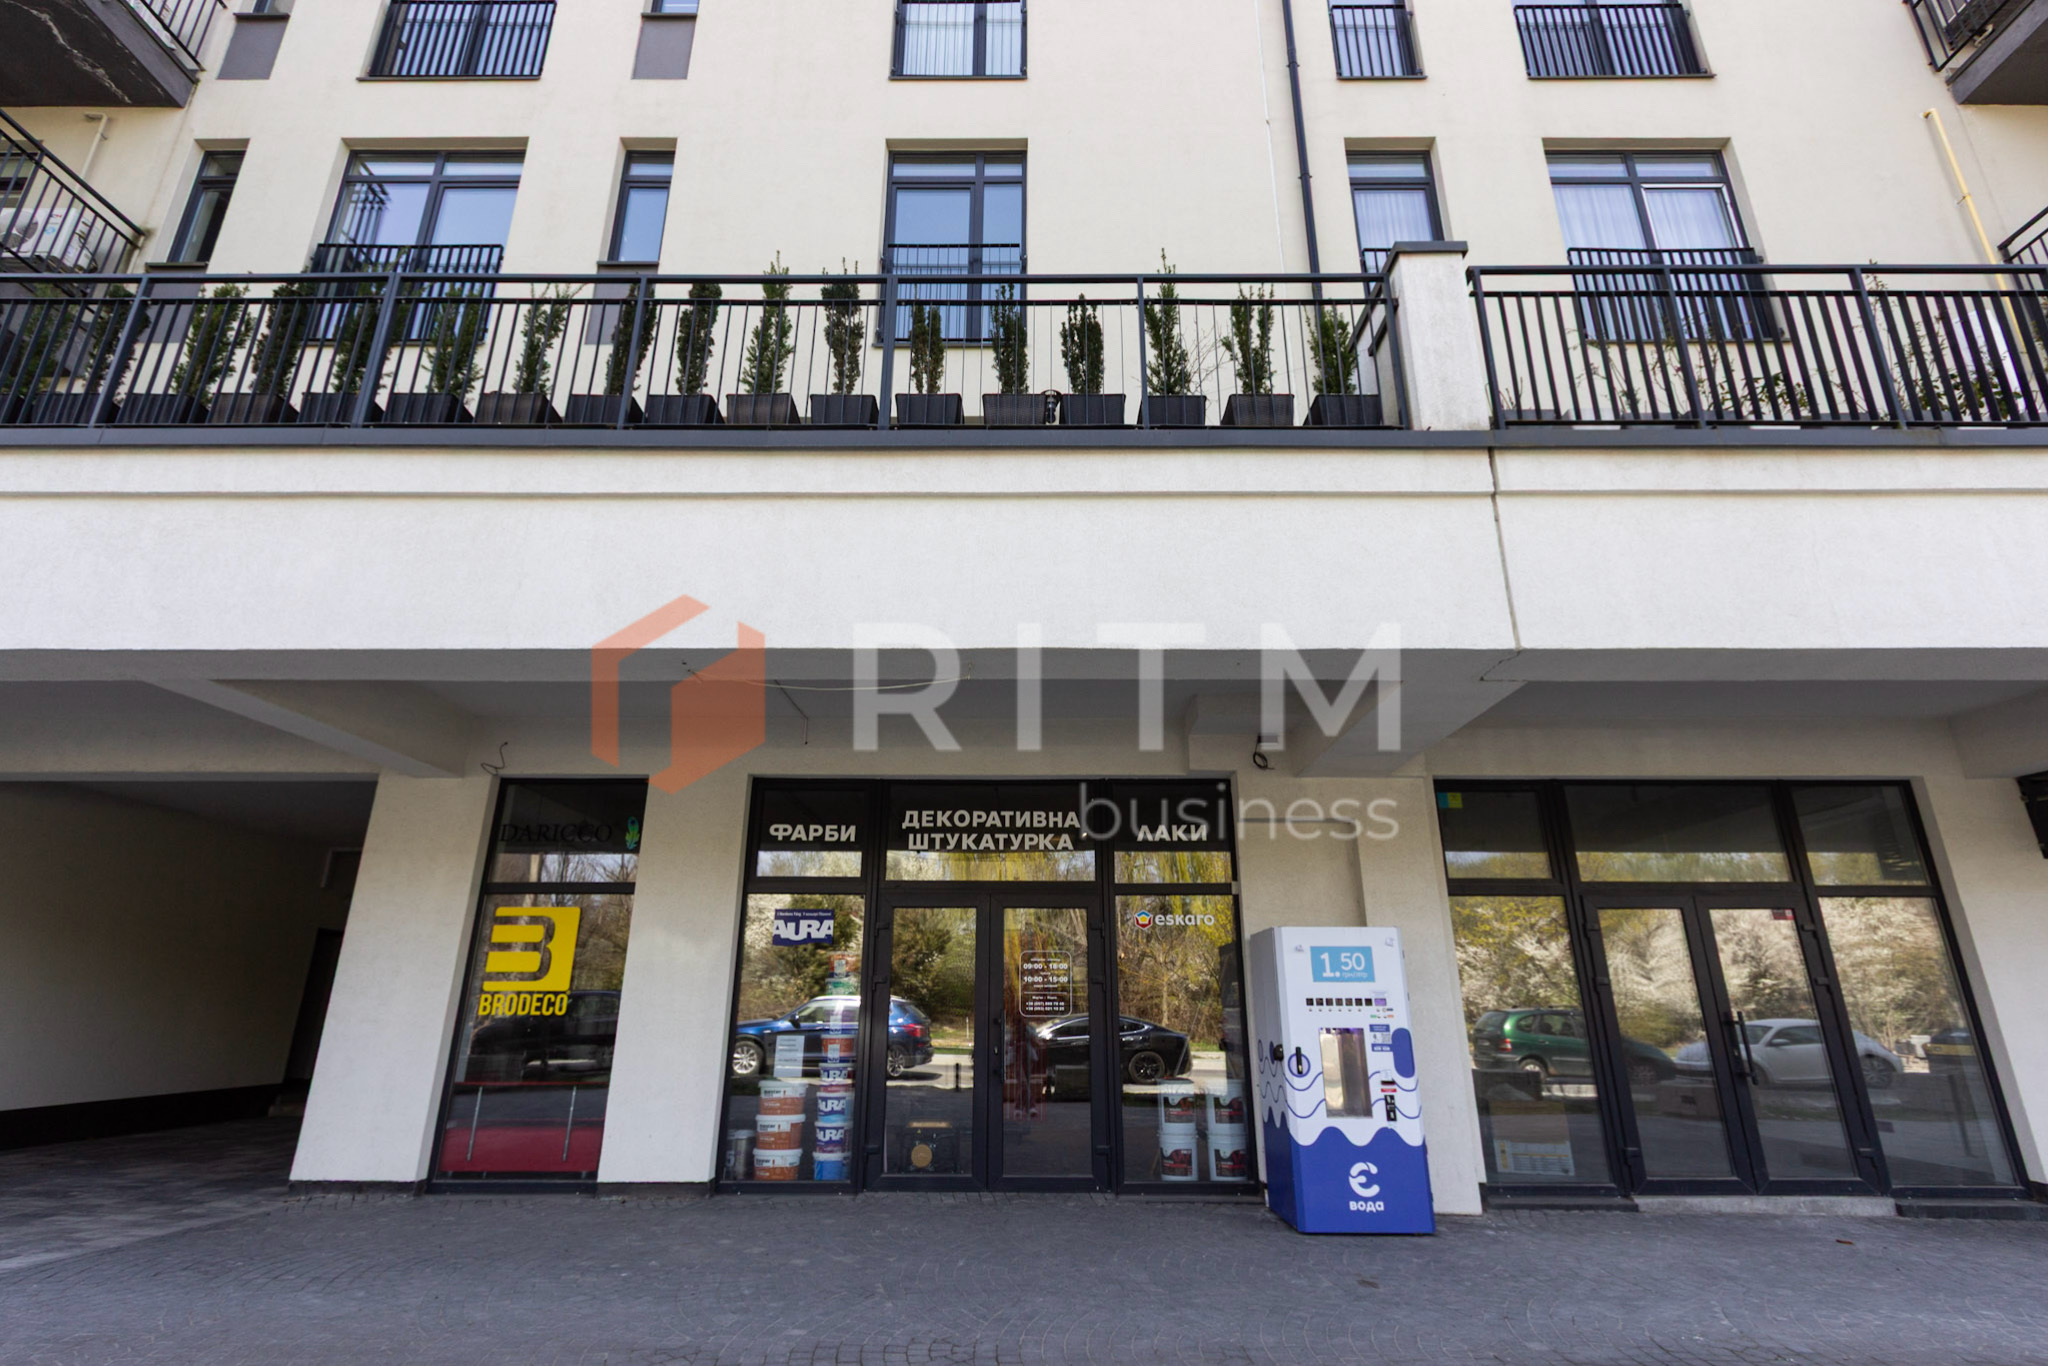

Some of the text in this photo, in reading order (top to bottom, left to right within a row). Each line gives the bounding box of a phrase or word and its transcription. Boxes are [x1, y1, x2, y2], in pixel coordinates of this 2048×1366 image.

[902, 810, 1081, 829] ДЕКОРАТИВНА
[500, 824, 613, 842] DARICCO
[769, 824, 856, 842] ФАРБИ
[908, 833, 1074, 850] ШТУКАТУРКА
[1137, 825, 1207, 841] ЛАКИ
[1155, 914, 1215, 926] eskaro
[773, 919, 834, 941] AURA
[478, 994, 568, 1016] BRODECO
[1349, 1200, 1384, 1213] вода
